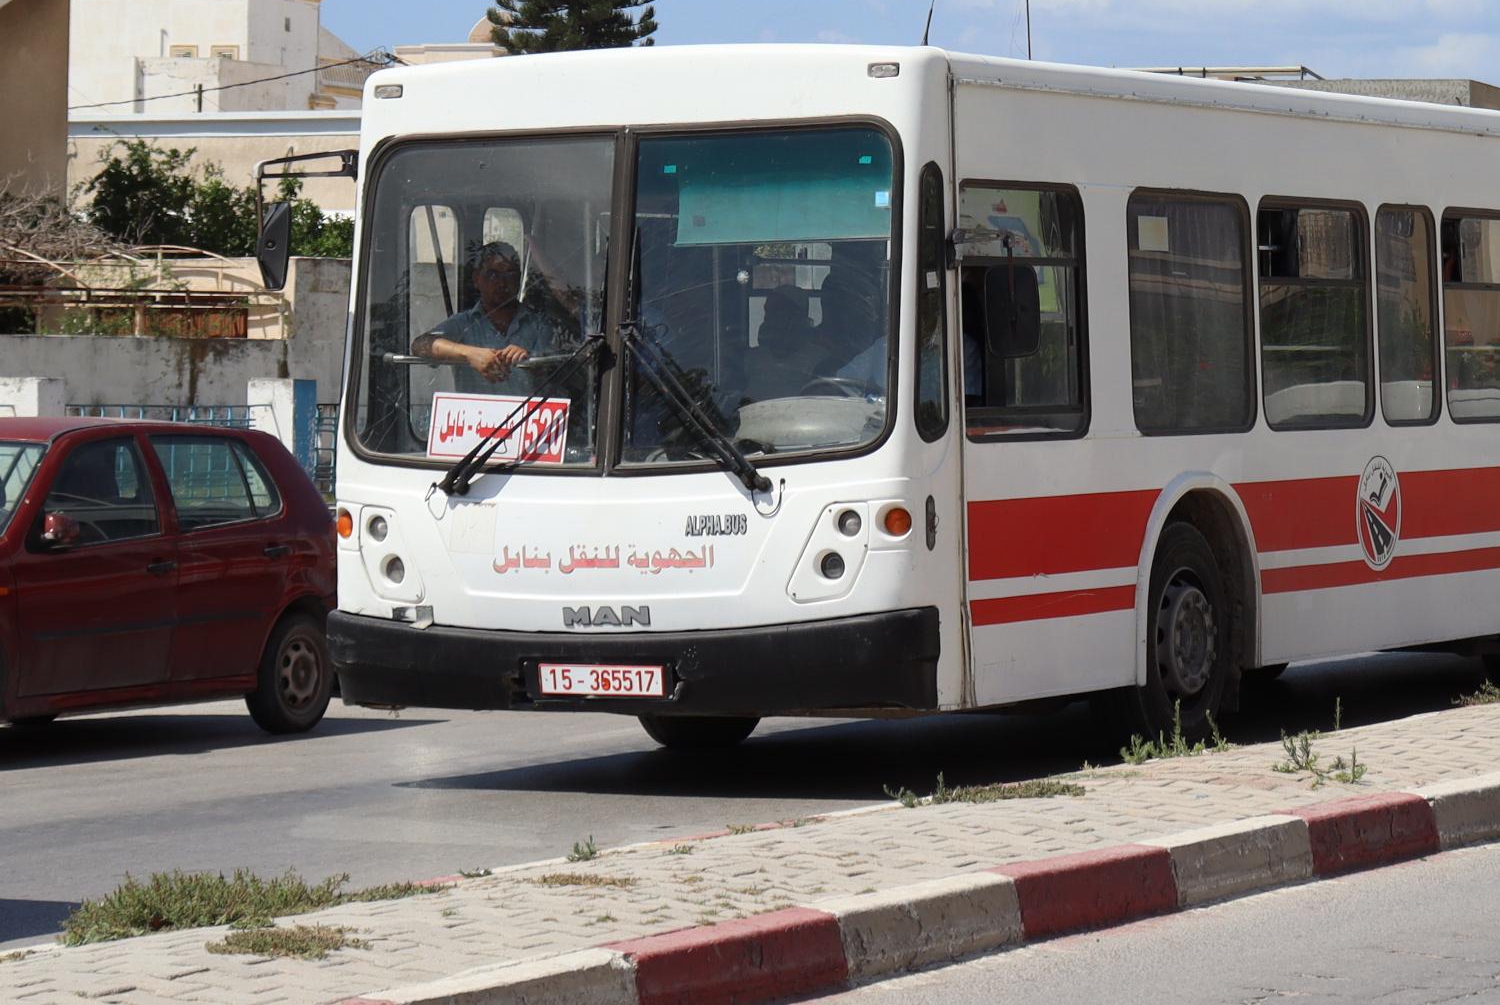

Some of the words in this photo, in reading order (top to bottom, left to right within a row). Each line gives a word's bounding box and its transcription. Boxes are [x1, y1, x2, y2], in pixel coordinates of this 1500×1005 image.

[440, 409, 465, 443] نابل
[524, 407, 564, 455] 520
[493, 545, 551, 575] بنابل
[558, 544, 620, 575] للنقل
[626, 544, 715, 575] الجهوية
[562, 605, 651, 627] MAN
